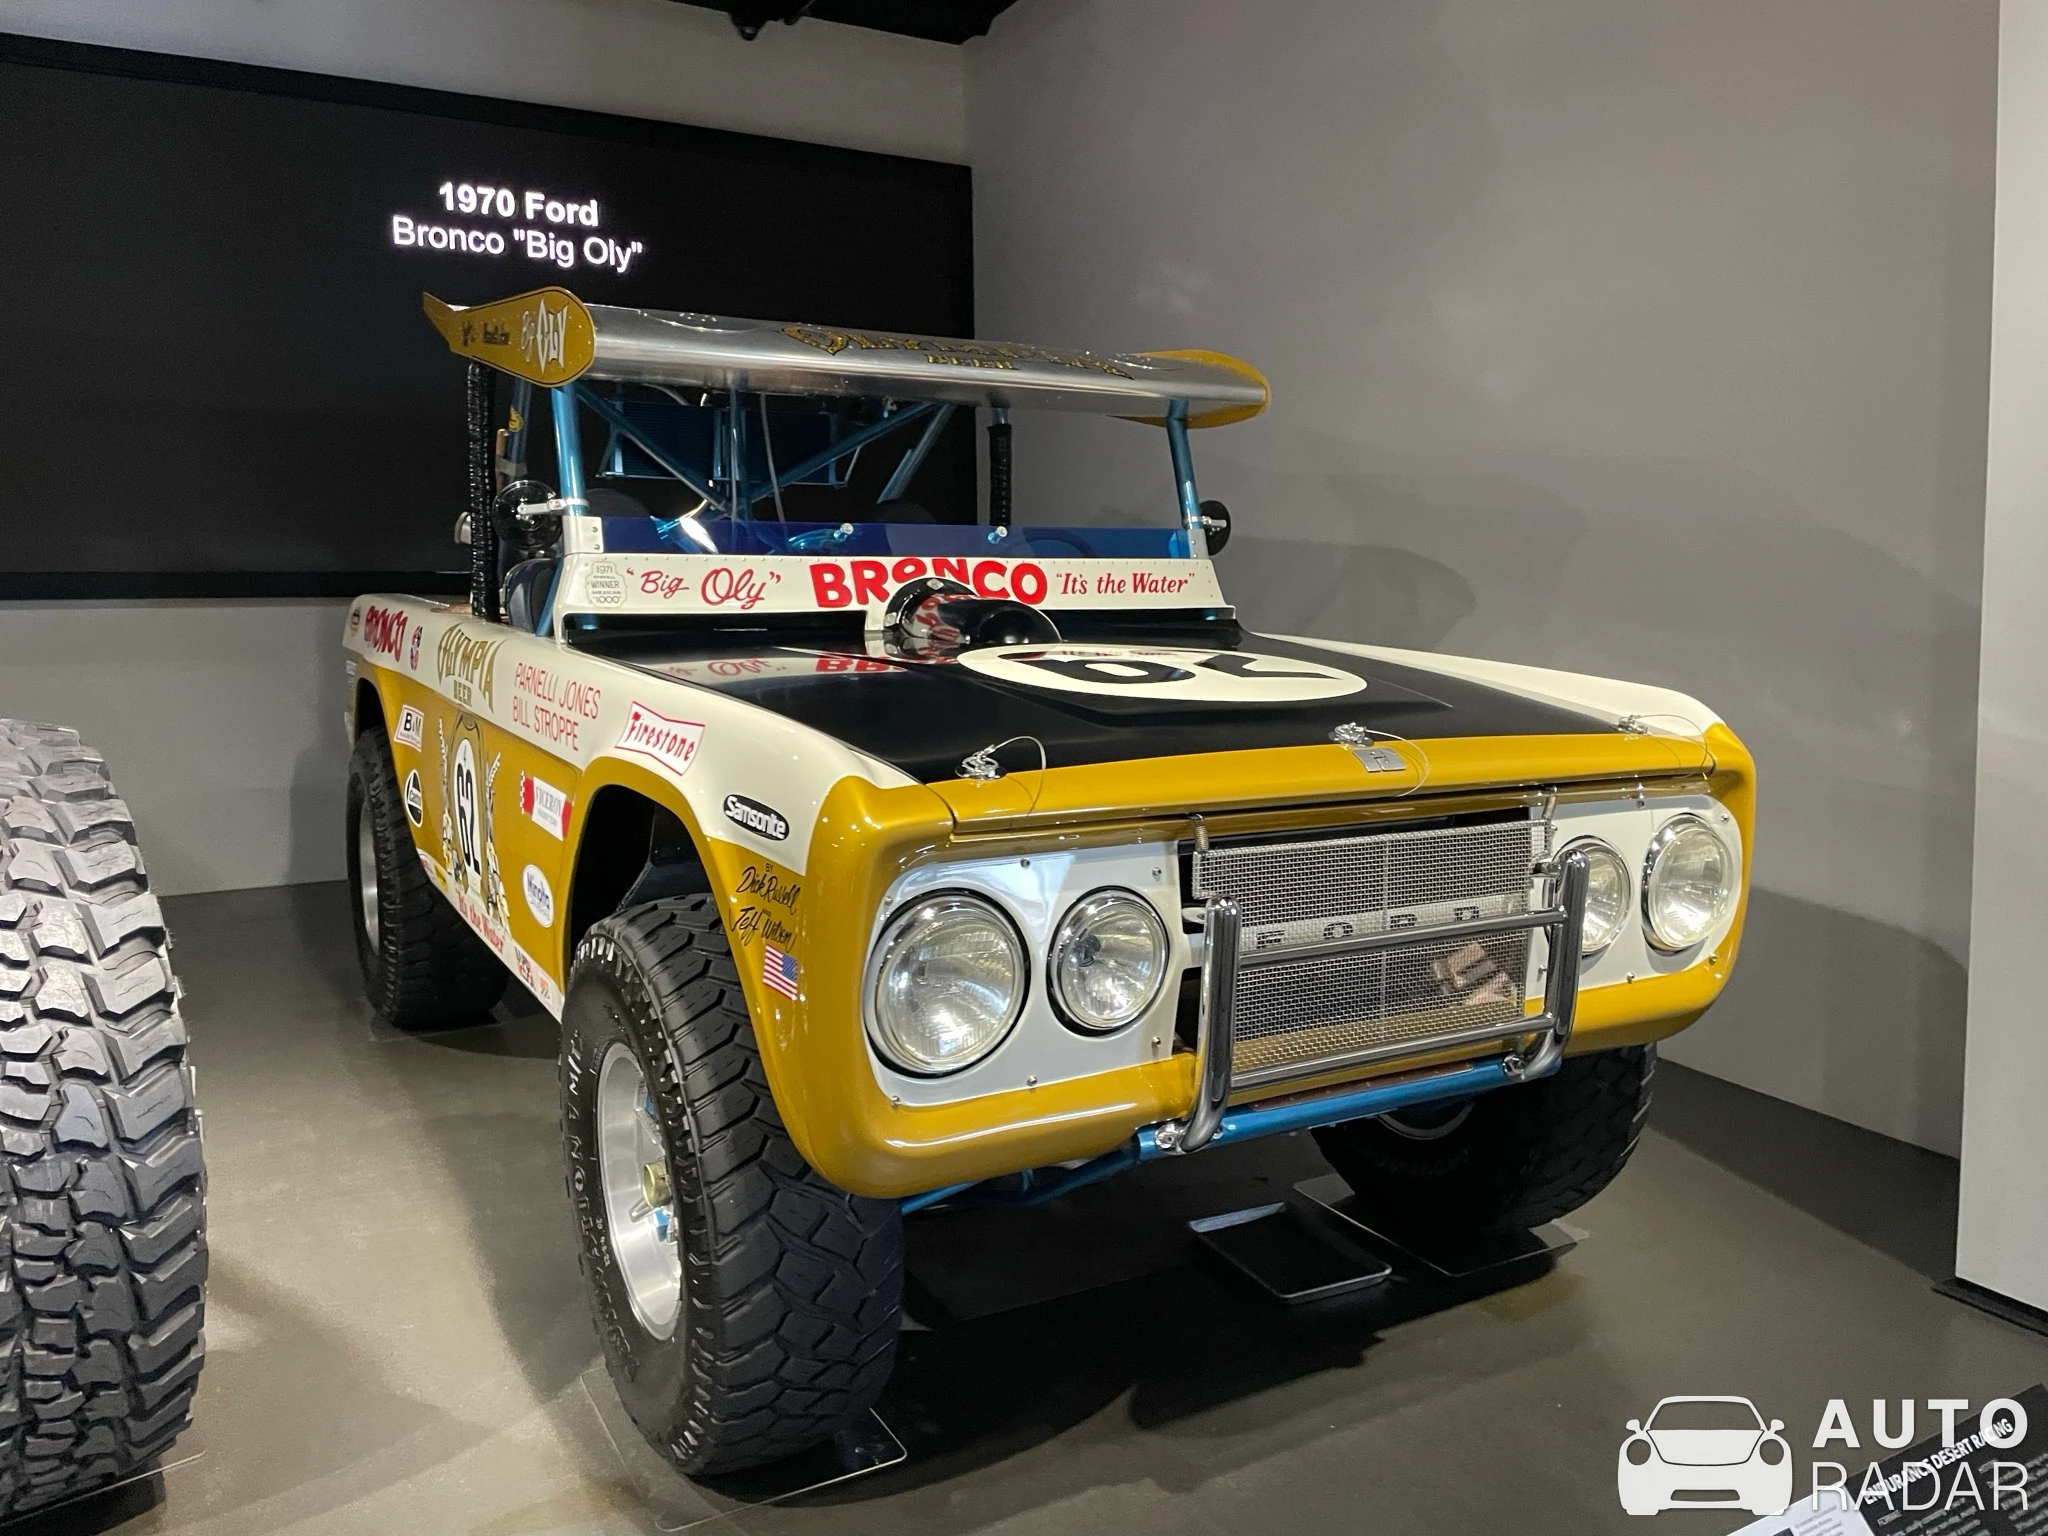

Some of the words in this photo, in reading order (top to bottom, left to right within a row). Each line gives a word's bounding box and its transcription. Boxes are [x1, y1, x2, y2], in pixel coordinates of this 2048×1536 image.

[438, 181, 516, 218] 1970
[524, 191, 599, 227] Ford
[391, 214, 505, 255] Bronco
[513, 229, 575, 268] "Big
[582, 236, 643, 273] Oly"
[590, 580, 621, 589] WINNER
[596, 565, 613, 574] 1971
[810, 556, 1049, 609] BRONCO
[1096, 573, 1127, 594] the
[363, 604, 409, 663] BRONCO
[436, 621, 510, 715] OLYMPIA
[513, 662, 560, 704] PARNELLI
[558, 679, 601, 720] JONES
[512, 695, 531, 729] BILL
[533, 704, 579, 752] STROPPE
[623, 710, 695, 763] Firestone
[724, 795, 786, 840] Samsonite
[1255, 905, 1480, 948] FORD
[1931, 1438, 1973, 1469] DESERT
